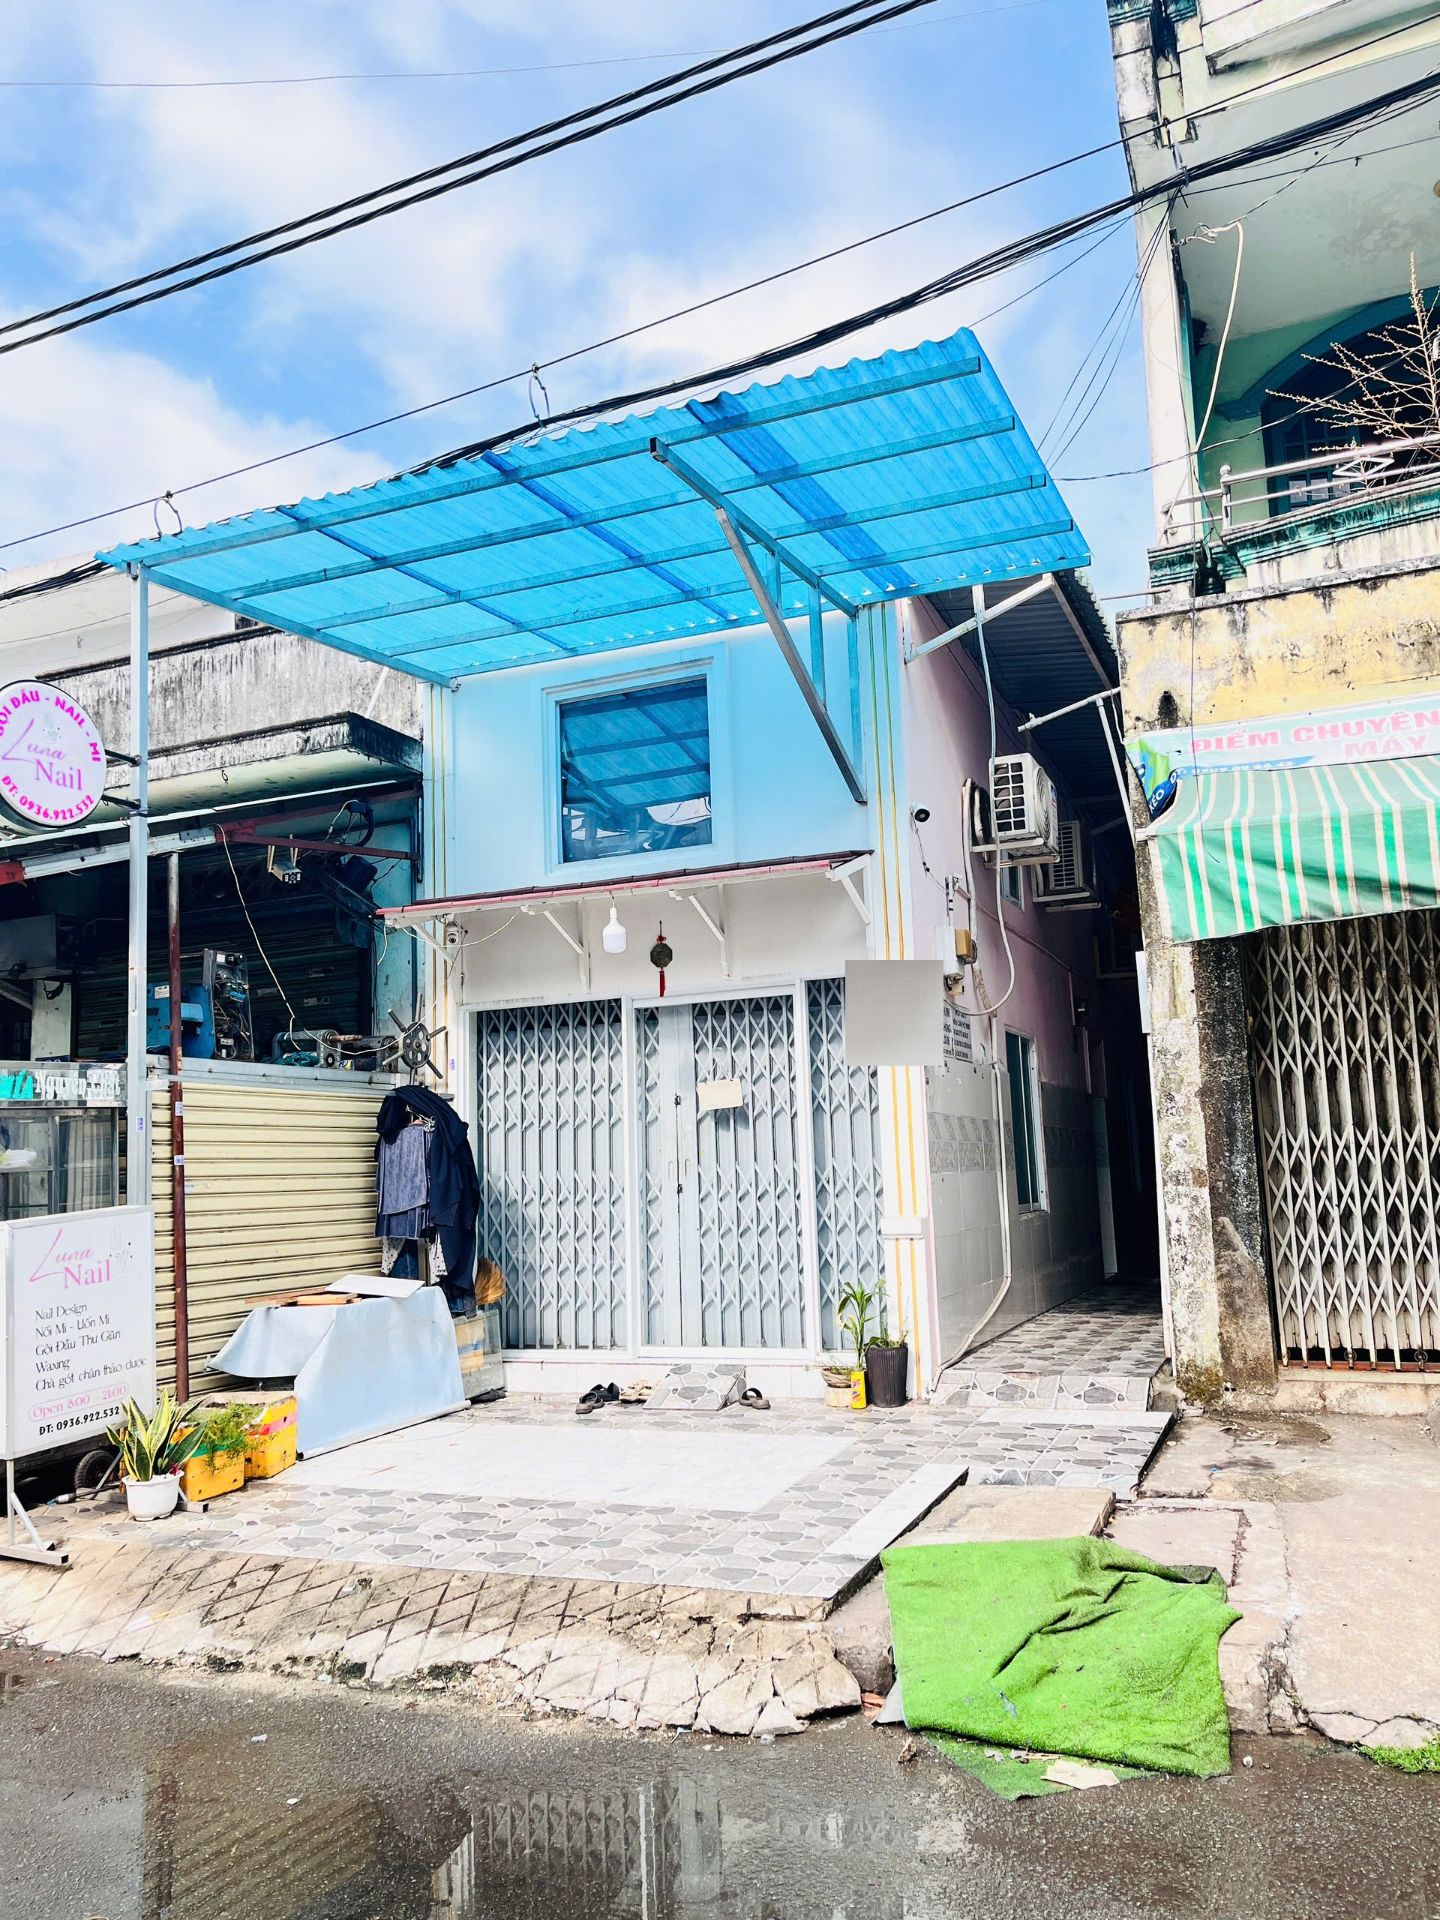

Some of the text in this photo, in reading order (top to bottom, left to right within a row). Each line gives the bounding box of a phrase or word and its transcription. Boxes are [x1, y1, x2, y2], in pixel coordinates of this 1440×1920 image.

[2, 718, 64, 762] Luna
[54, 696, 86, 728] NAIL
[89, 742, 102, 763] MI
[34, 758, 82, 791] Nail
[19, 794, 95, 821] 0936.922.532
[29, 1228, 93, 1282] Luna
[63, 1259, 111, 1289] Nail
[35, 1303, 88, 1320] Nail Design
[36, 1359, 71, 1373] Waxing
[32, 1404, 64, 1418] Open
[56, 1406, 120, 1431] 0936.922.532
